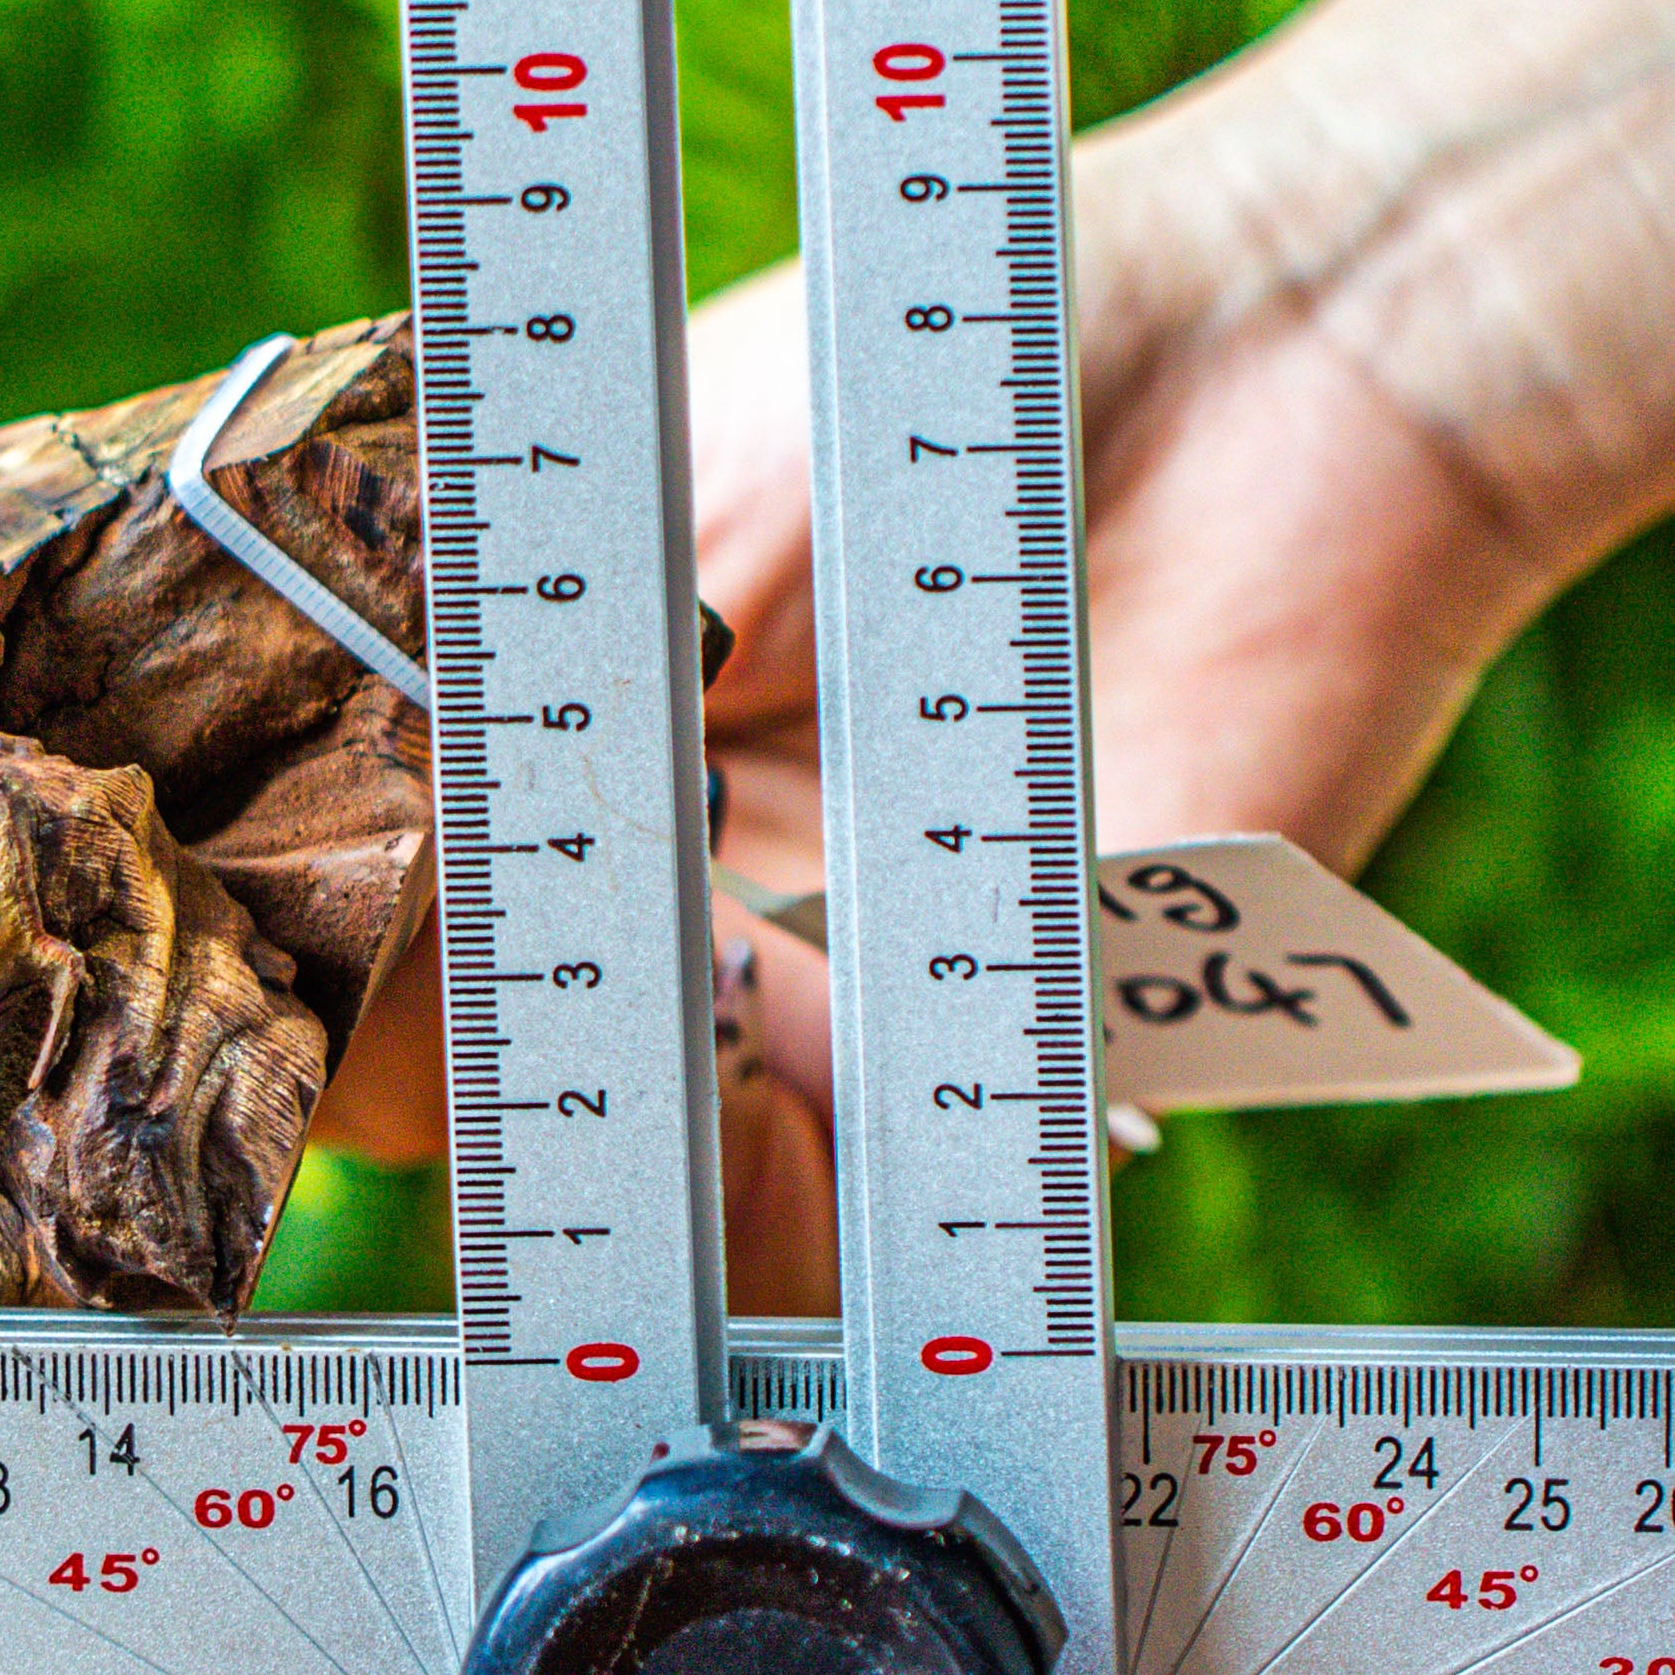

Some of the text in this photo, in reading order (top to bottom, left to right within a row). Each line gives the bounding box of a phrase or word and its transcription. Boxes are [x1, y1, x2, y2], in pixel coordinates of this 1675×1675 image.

[512, 52, 588, 133] 10
[872, 43, 946, 122] 10
[520, 184, 570, 214] 9
[899, 174, 949, 203] 9
[525, 314, 575, 344] 8
[904, 304, 954, 333] 8
[531, 444, 580, 473] 7
[909, 435, 958, 464] 7
[536, 573, 586, 603] 6
[914, 565, 963, 593] 6
[541, 702, 591, 732] 5
[919, 694, 968, 722] 5
[547, 832, 595, 863] 4
[924, 824, 972, 854] 4
[552, 961, 602, 989] 3
[928, 953, 978, 981] 3
[1102, 951, 1410, 1045] 047
[557, 1089, 606, 1118] 2
[933, 1083, 982, 1110] 2
[562, 1227, 611, 1245] 1
[938, 1221, 986, 1238] 1
[565, 1342, 640, 1383] 0
[920, 1335, 993, 1376] 0
[281, 1419, 367, 1465] 75°
[1191, 1429, 1277, 1476] 75°
[78, 1422, 141, 1477] 14
[337, 1465, 399, 1520] 16
[1119, 1435, 1675, 1533] 22 24 25 2
[194, 1483, 295, 1529] 60°
[1302, 1496, 1405, 1543] 60°
[48, 1547, 160, 1593] 45°
[1426, 1564, 1539, 1611] 45°
